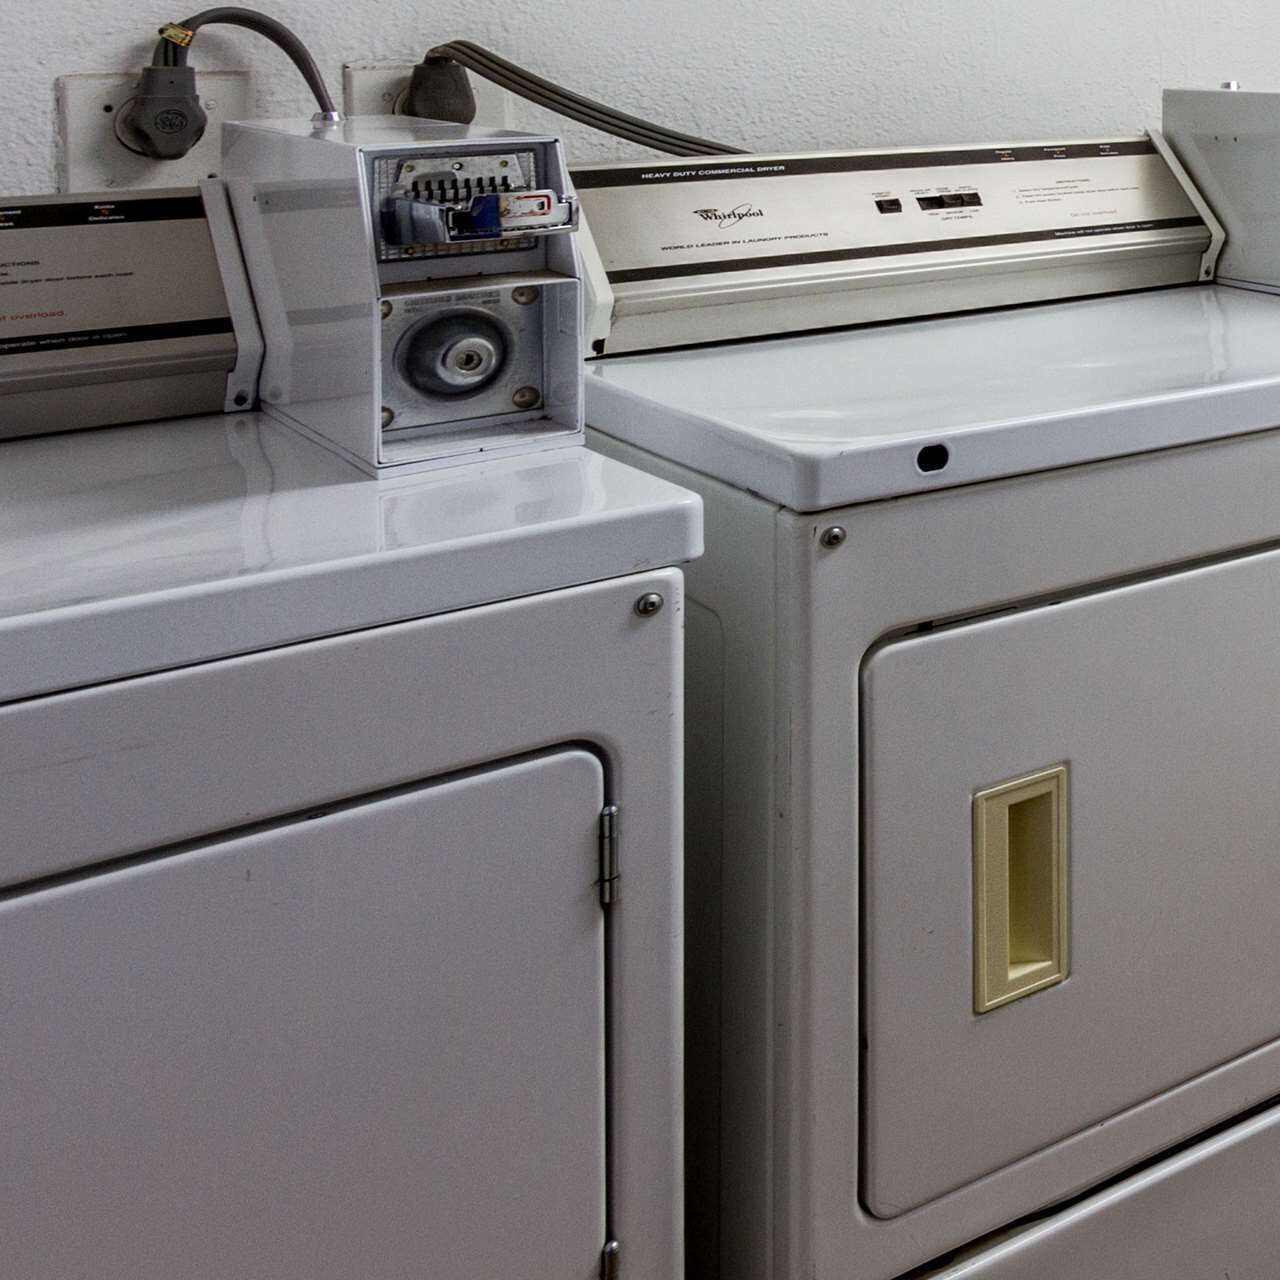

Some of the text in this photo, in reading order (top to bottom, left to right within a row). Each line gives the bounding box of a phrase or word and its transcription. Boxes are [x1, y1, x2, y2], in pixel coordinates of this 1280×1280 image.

[641, 171, 671, 179] HEAVY
[673, 170, 697, 178] DUTY
[698, 167, 755, 176] COMMERCIAL
[700, 209, 764, 222] Whirlpool
